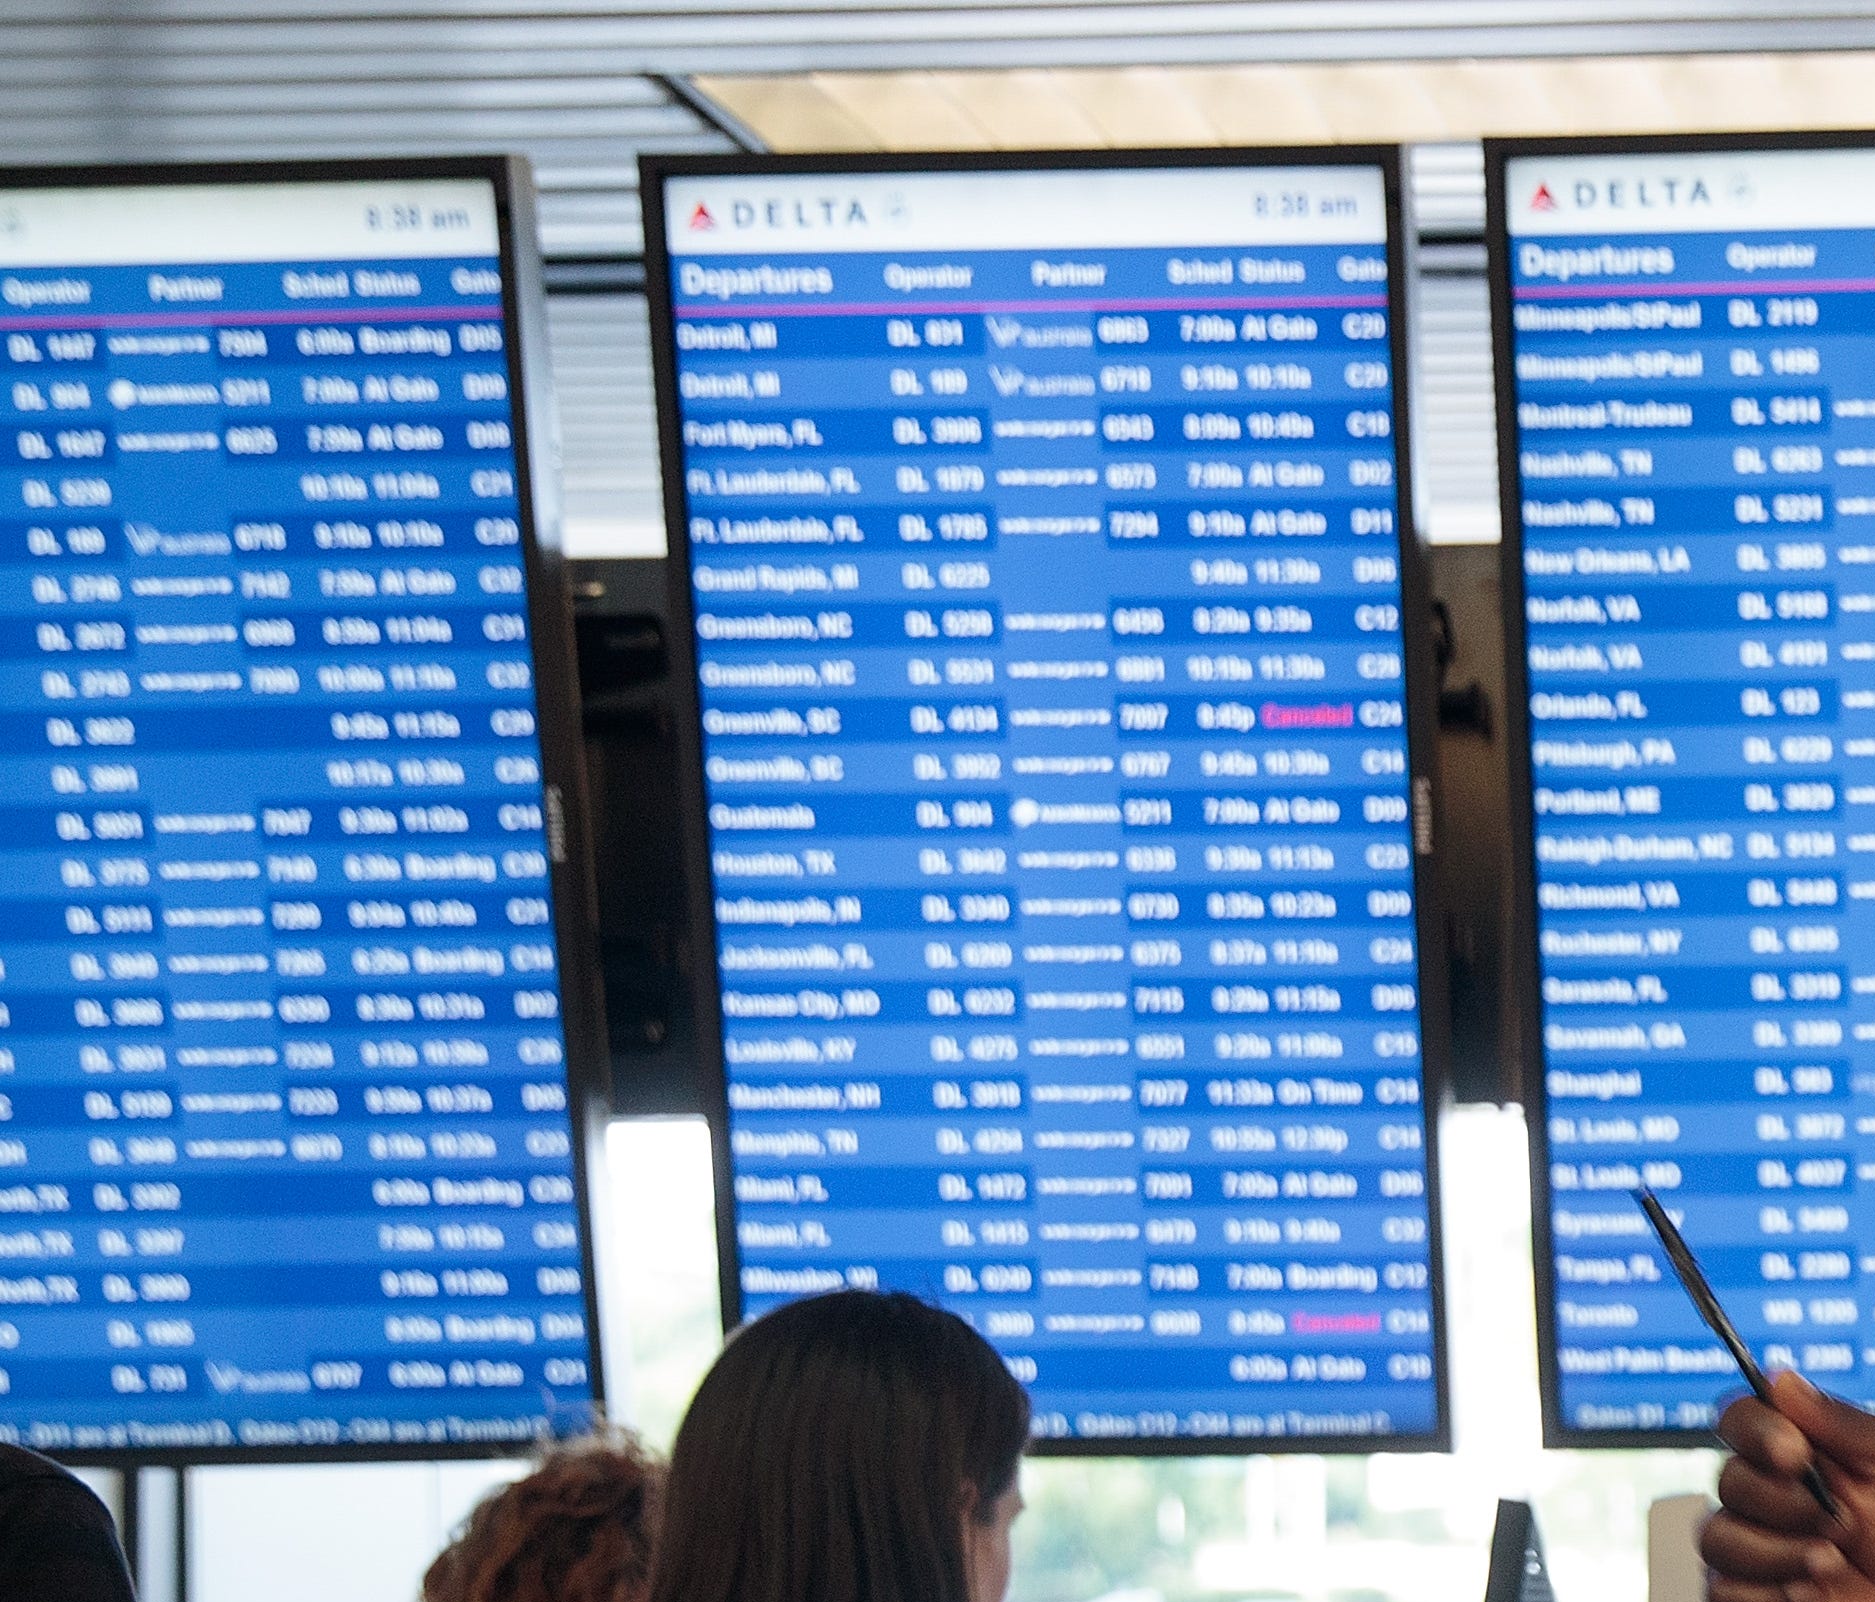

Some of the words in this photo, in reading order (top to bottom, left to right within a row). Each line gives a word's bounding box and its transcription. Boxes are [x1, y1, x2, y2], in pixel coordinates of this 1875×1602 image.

[1575, 180, 1711, 208] DELTA
[732, 199, 868, 228] DELTA
[1519, 243, 1675, 279] Departures
[1726, 242, 1816, 272] Operator
[148, 274, 224, 302] Partner
[354, 270, 422, 298] Status
[680, 263, 834, 300] Departures
[883, 263, 973, 293] Operator
[1031, 261, 1106, 288] Partner
[1167, 259, 1234, 286] Sched
[1239, 258, 1306, 285] Status
[1337, 256, 1388, 283] Gate
[709, 804, 816, 830] Guatemala
